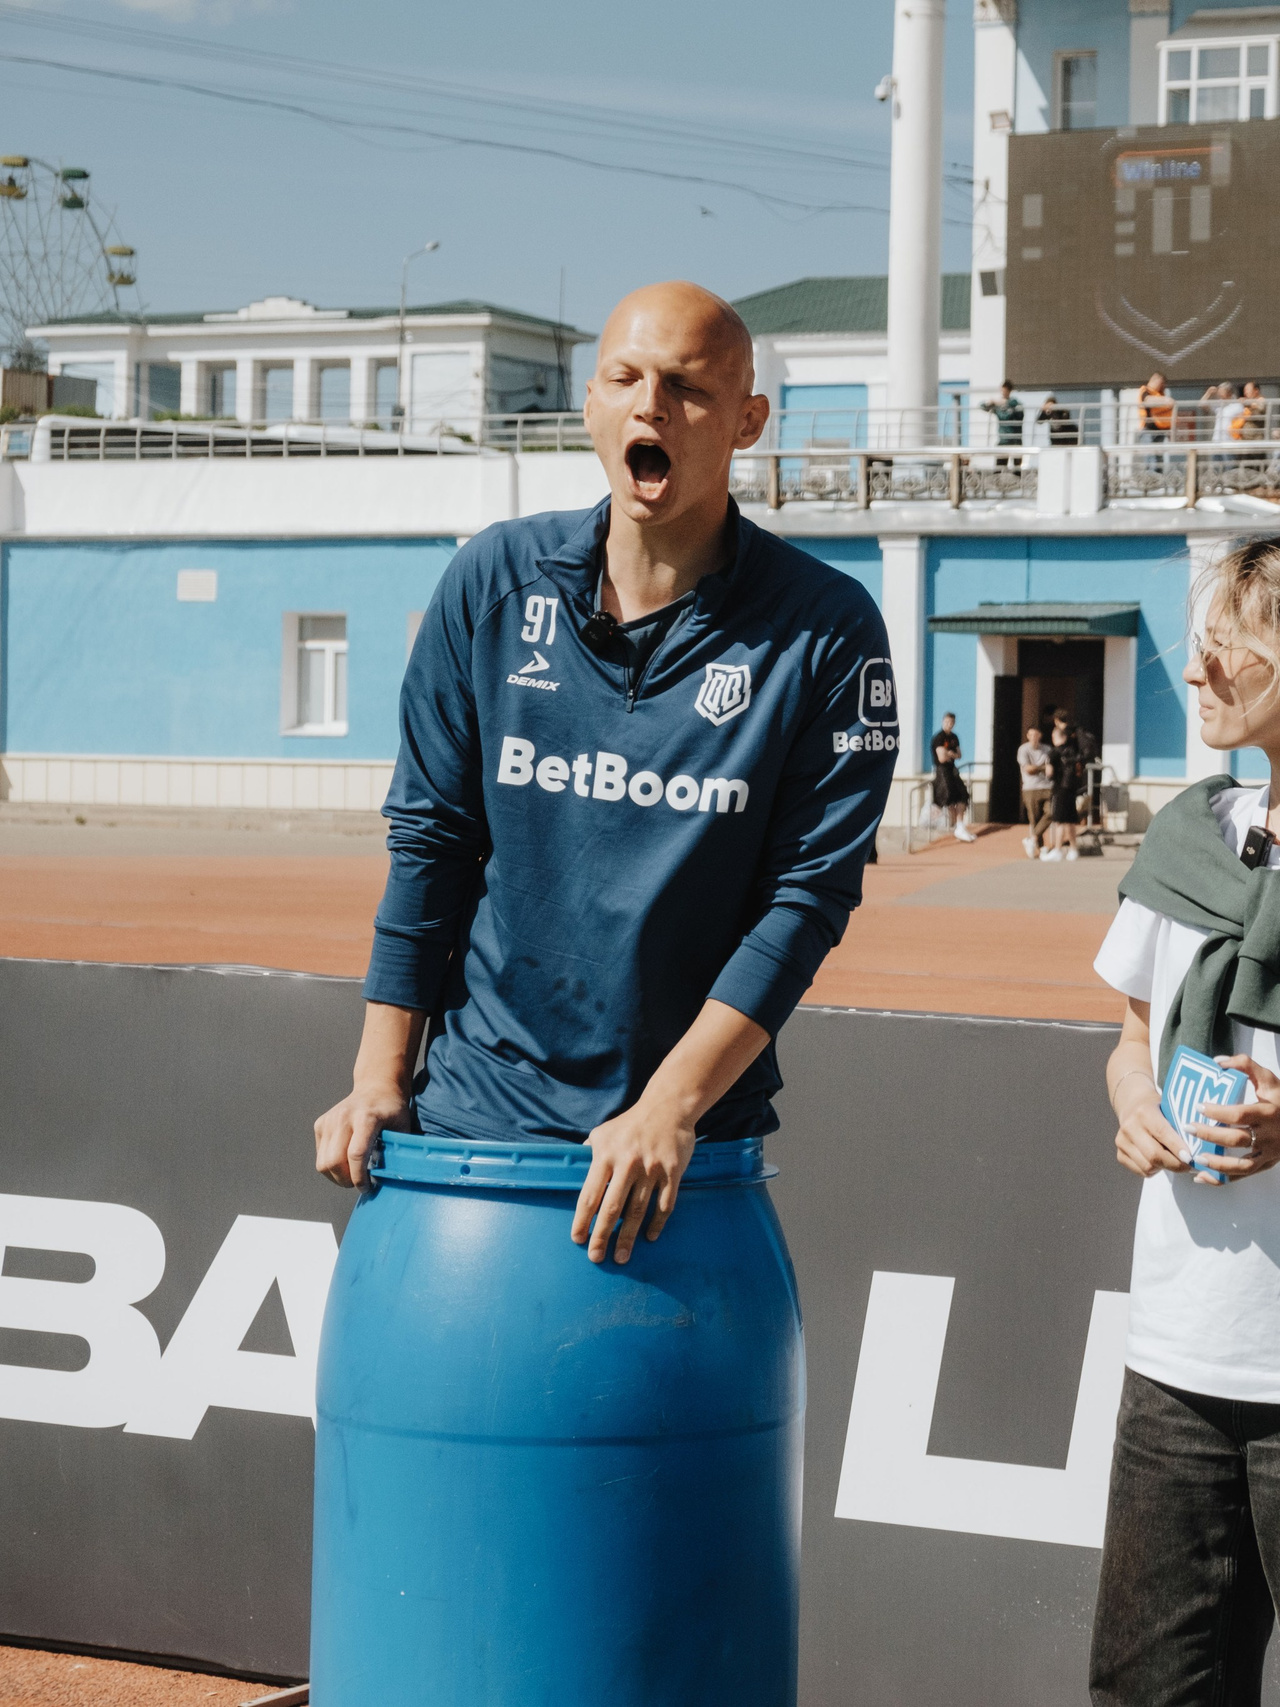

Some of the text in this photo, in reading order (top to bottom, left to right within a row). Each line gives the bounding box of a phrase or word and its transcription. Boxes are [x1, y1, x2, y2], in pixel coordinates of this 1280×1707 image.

[1122, 160, 1201, 181] winline
[521, 595, 559, 646] 97
[506, 674, 560, 691] DEMIX
[870, 679, 892, 707] BB
[832, 729, 900, 753] BetBo
[497, 735, 750, 814] BetBoom
[0, 1193, 341, 1440] BA
